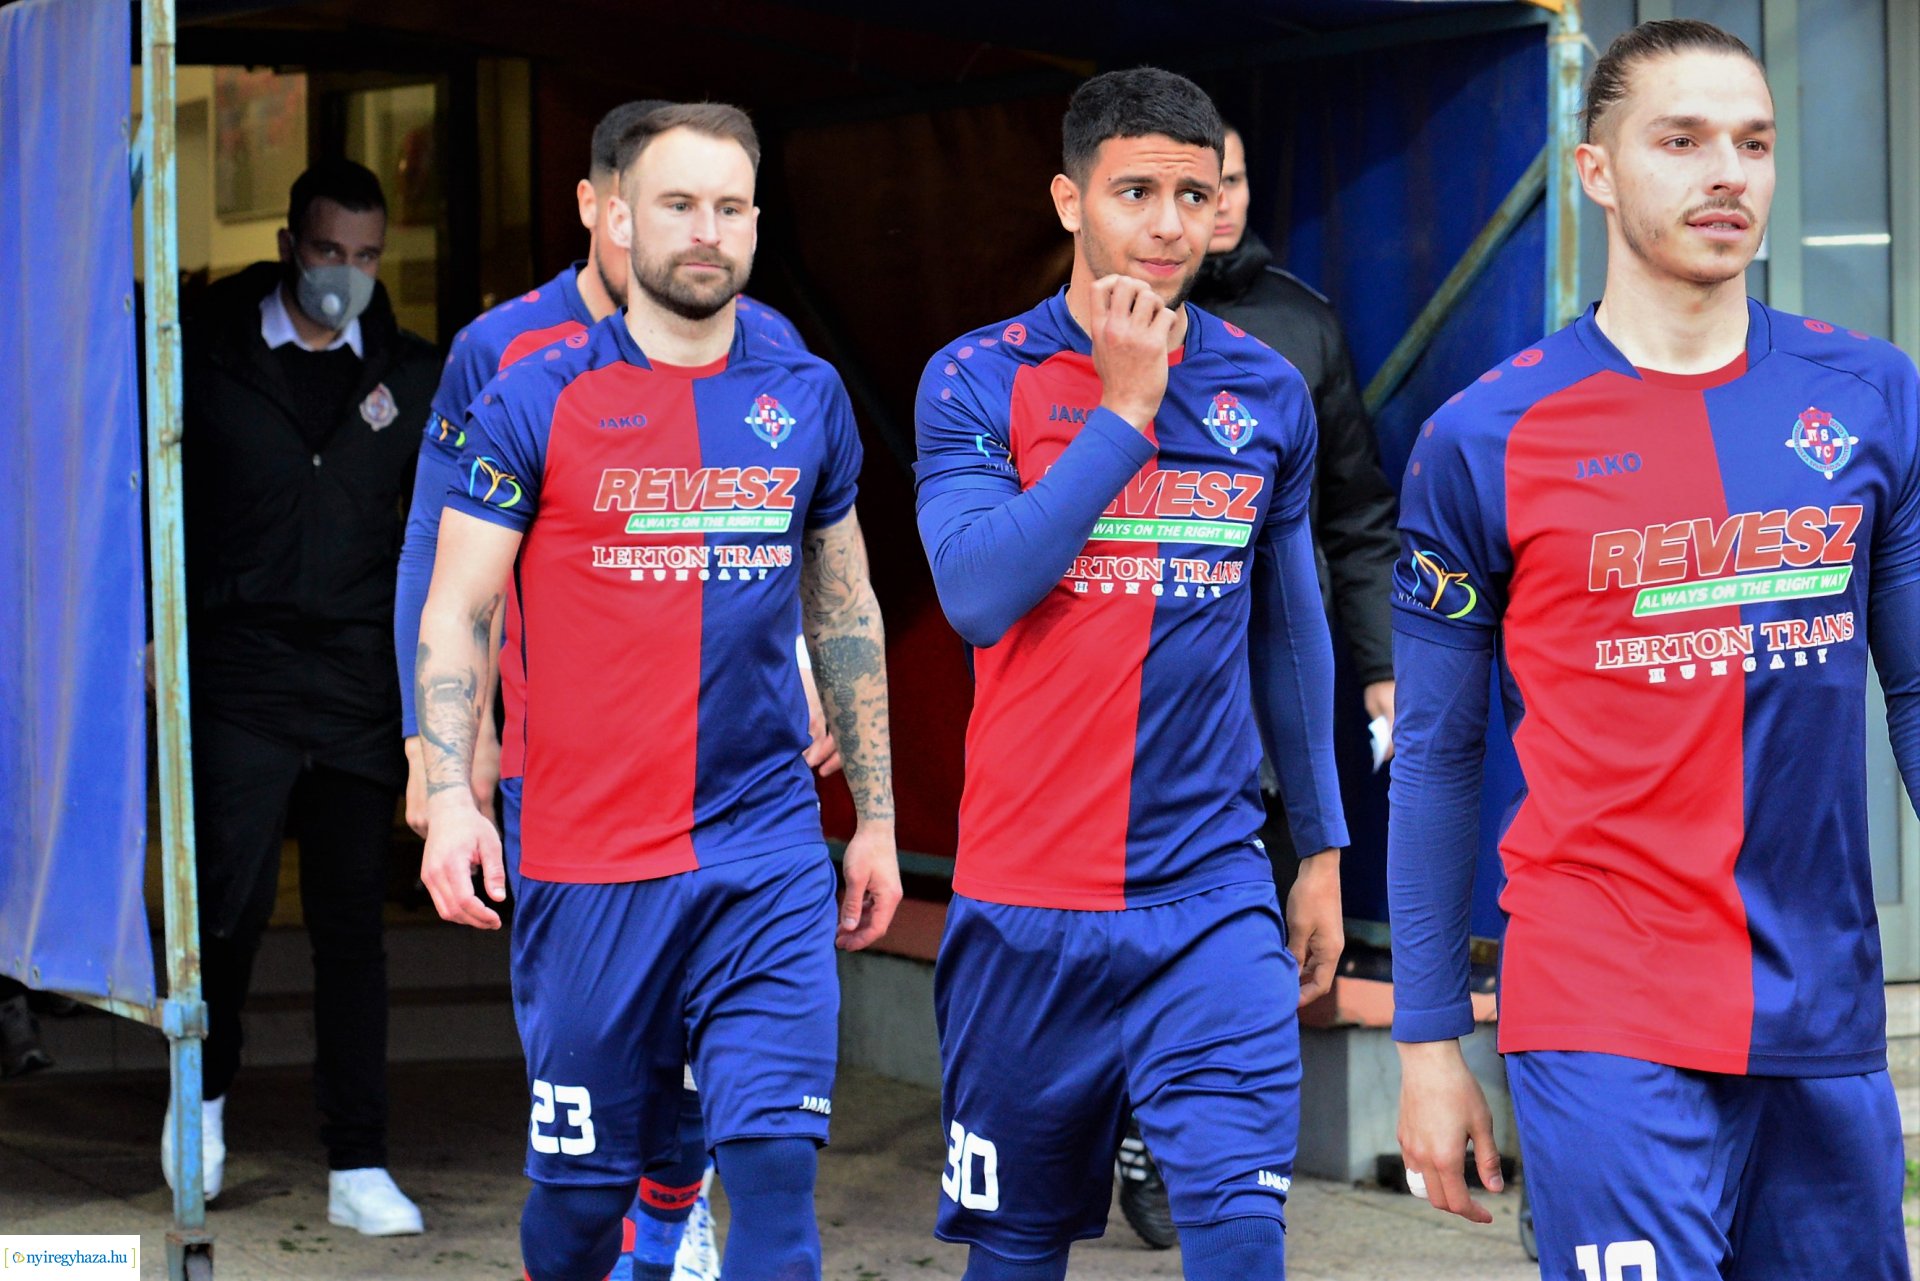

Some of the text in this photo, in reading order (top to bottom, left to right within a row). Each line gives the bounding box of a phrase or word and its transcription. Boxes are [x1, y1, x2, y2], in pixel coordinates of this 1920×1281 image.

[1574, 452, 1643, 480] JAKO
[593, 466, 801, 512] REVESZ
[1103, 469, 1264, 522] VESZ
[631, 515, 786, 528] ALWAYS ON THE RIGHT WAY
[1092, 522, 1247, 541] WAYS ON THE RIGHT WAY
[592, 545, 793, 569] LERTON TRANS
[1588, 505, 1864, 592] REVESZ
[630, 568, 768, 582] HUNGARY
[1064, 556, 1244, 584] RTON TRANS
[1074, 581, 1222, 599] HUNGARY
[1640, 571, 1846, 609] ALWAYS ON THE RIGHT WAY
[1595, 611, 1854, 671] LERTON TRANS
[1649, 648, 1828, 684] HUNGARY
[531, 1079, 596, 1156] 23
[942, 1119, 999, 1212] 30
